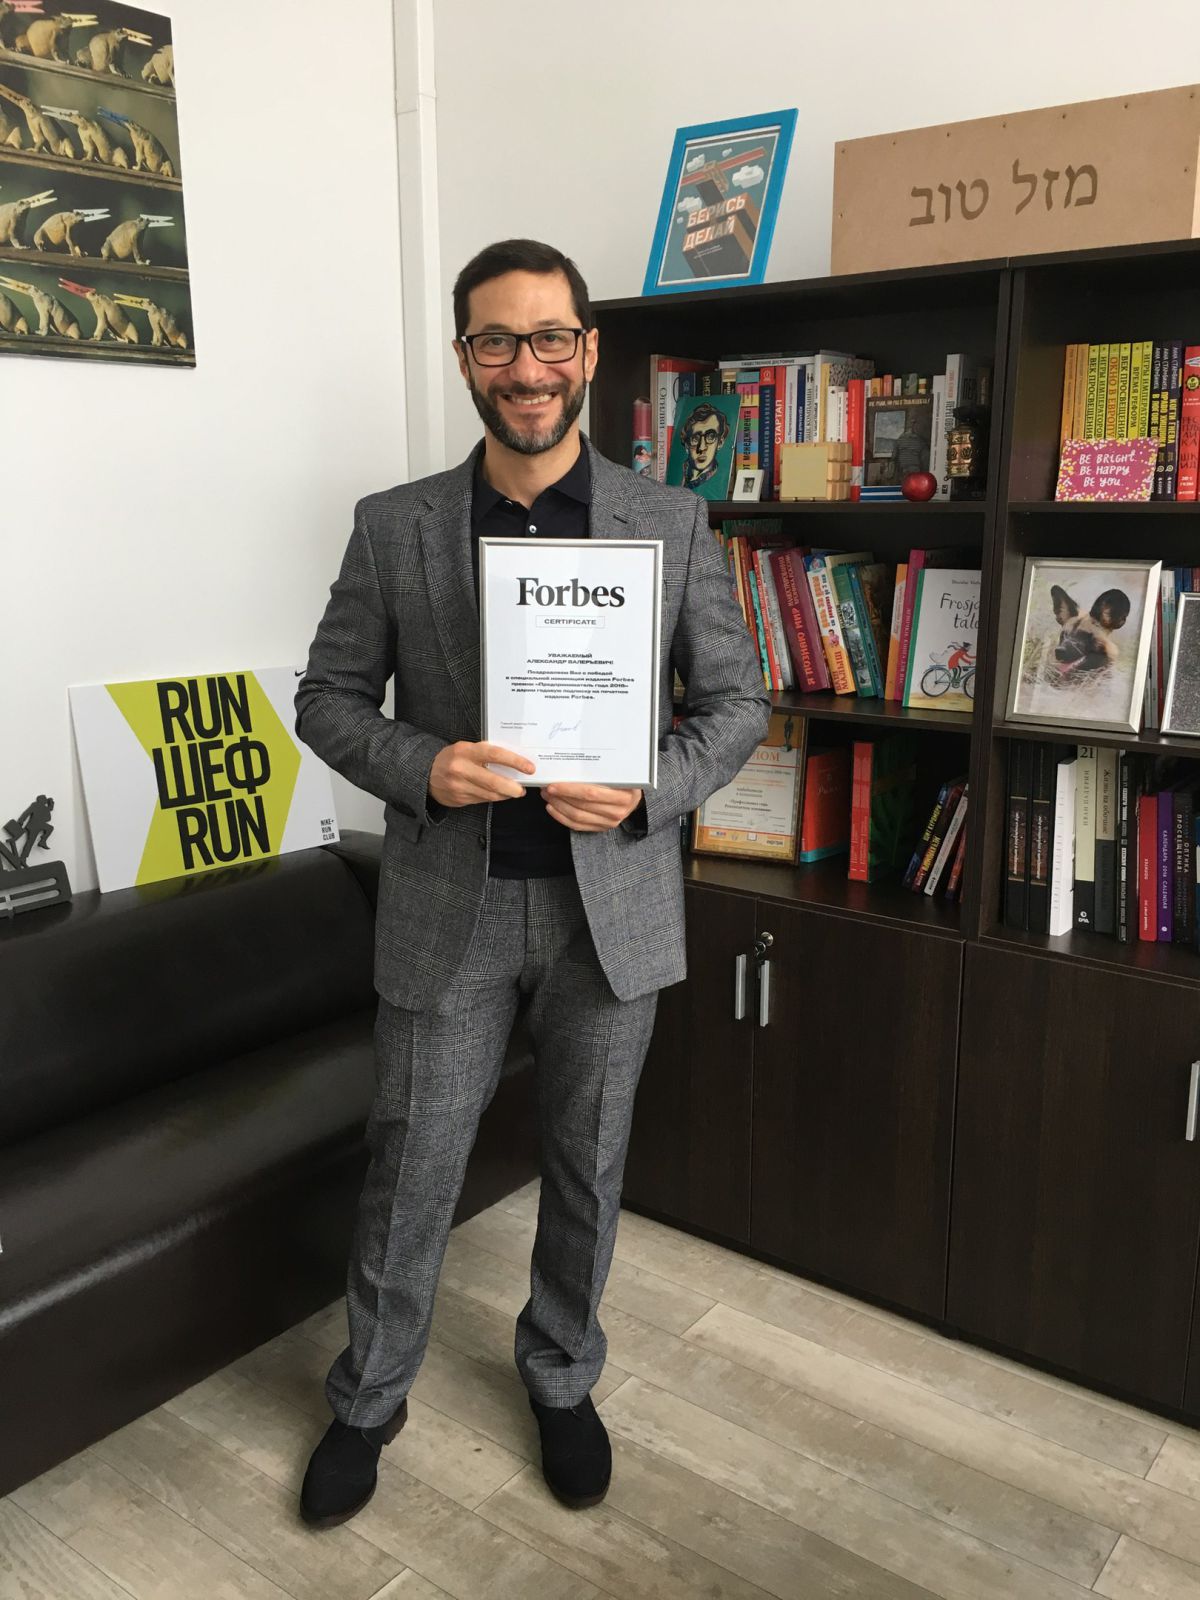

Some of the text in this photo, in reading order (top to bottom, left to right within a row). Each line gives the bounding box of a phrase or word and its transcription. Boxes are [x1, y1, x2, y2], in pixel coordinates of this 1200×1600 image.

[687, 194, 746, 228] БЕРИСЬ
[909, 158, 1098, 227] מזל טוב
[683, 215, 736, 251] ДЕЛАЙ
[1109, 356, 1118, 386] ОКНО
[1086, 357, 1097, 439] ВЕК ПРОСВЕЩЕНИЯ
[1096, 356, 1107, 438] ИГРЫ ИМПЕРАТОРОВ
[1106, 398, 1115, 437] ЕВРОПУ
[1117, 355, 1129, 439] ВЕК ПРОСВЕЩЕНИЯ
[1130, 366, 1140, 427] ВРЕМЯ РЕФОРМ
[1139, 378, 1149, 438] ИМПЕРАТОРОВ
[742, 410, 752, 460] менеджмента
[774, 399, 783, 444] СТАРТАП
[1079, 454, 1091, 464] BE
[1079, 465, 1092, 475] BE
[1083, 476, 1095, 487] BE
[516, 577, 625, 607] Forbes
[791, 607, 816, 686] Я ПОЗНАЮ МИР
[834, 651, 849, 690] МАЛЫШ
[156, 674, 252, 744] RUN
[152, 736, 271, 810] ШЕФ
[1080, 746, 1095, 759] 21
[1103, 769, 1112, 794] Жизнь
[176, 795, 271, 870] RUN
[322, 832, 336, 841] CLUB
